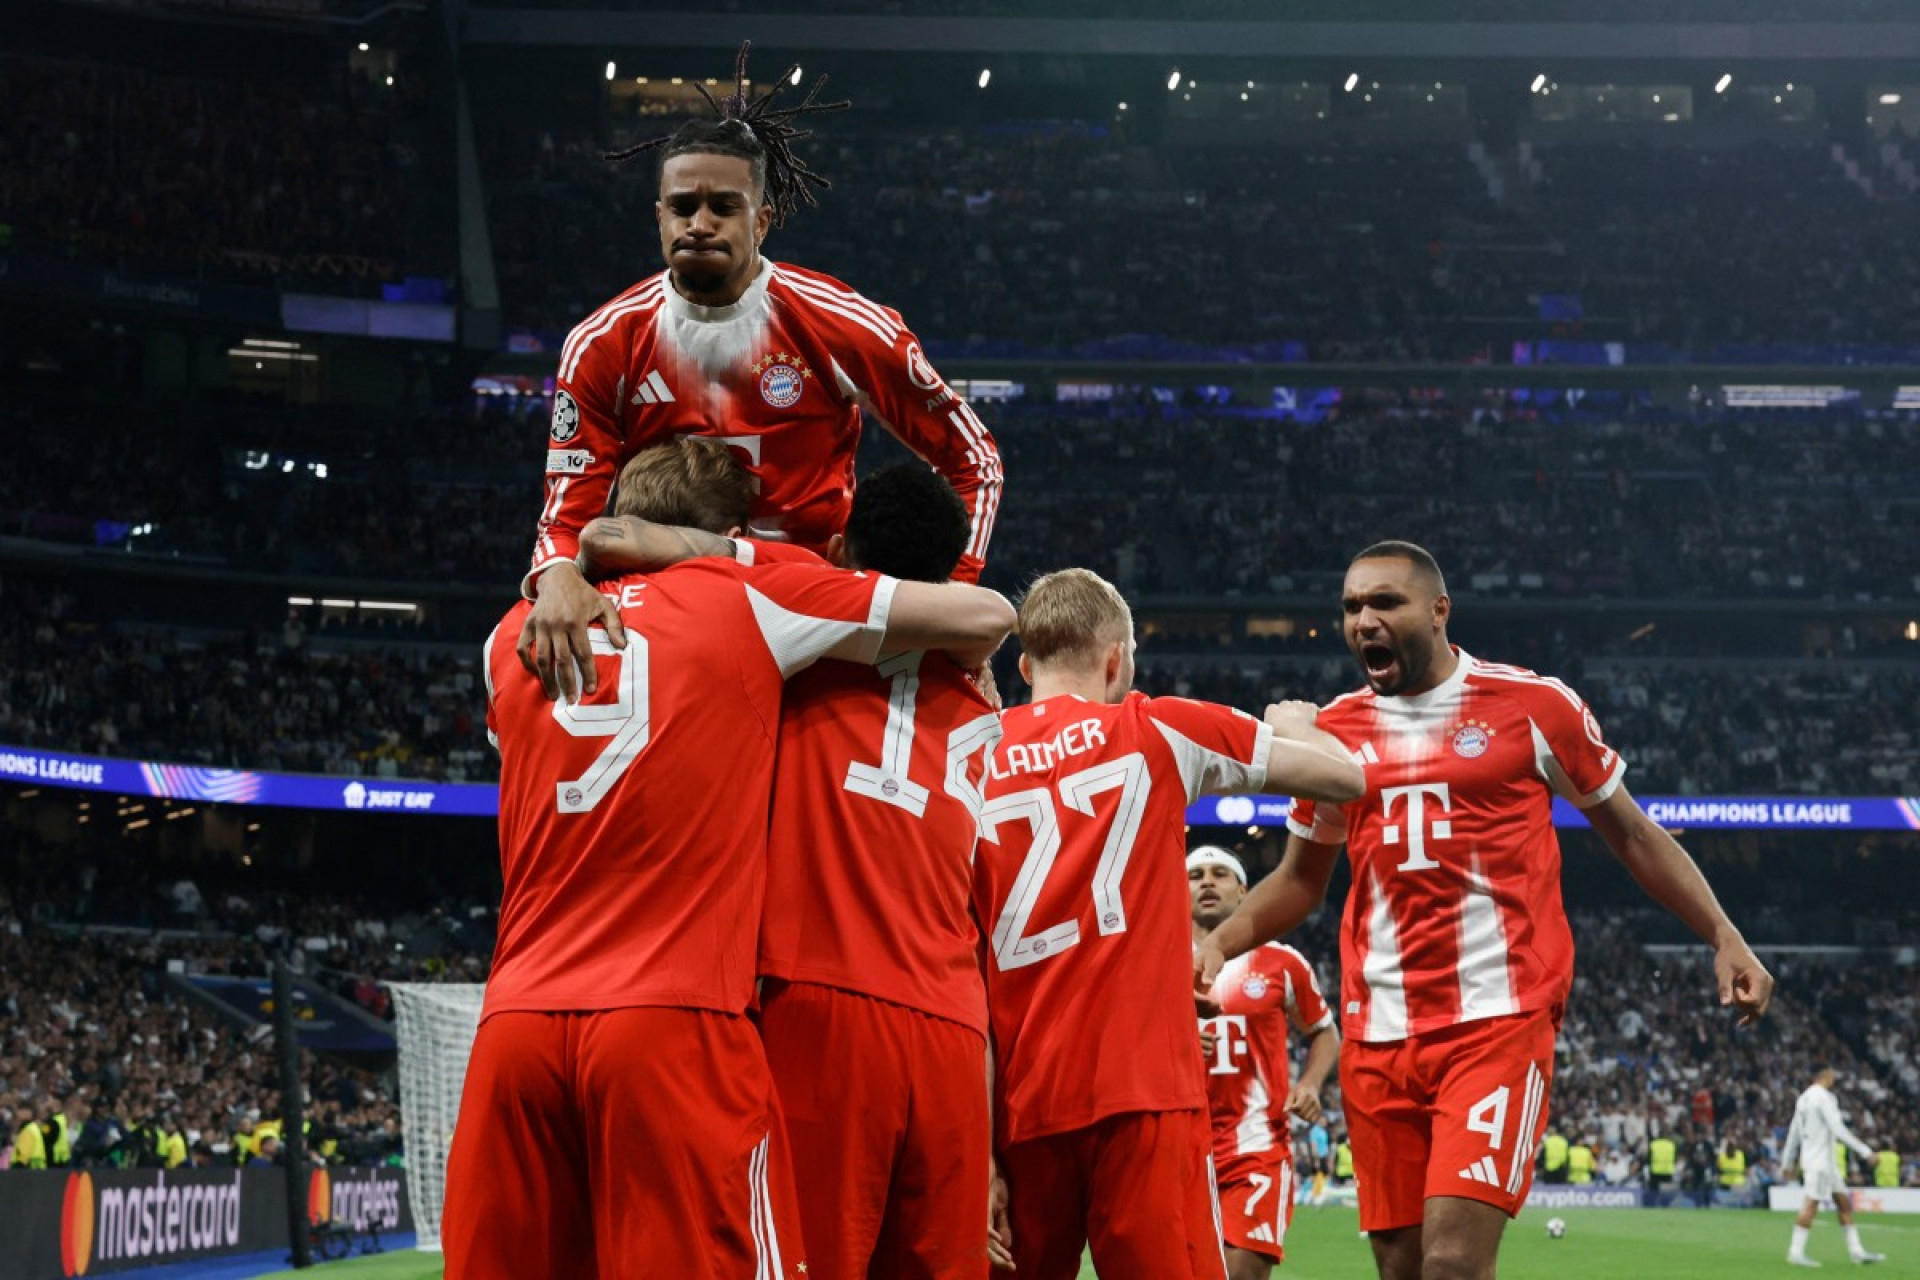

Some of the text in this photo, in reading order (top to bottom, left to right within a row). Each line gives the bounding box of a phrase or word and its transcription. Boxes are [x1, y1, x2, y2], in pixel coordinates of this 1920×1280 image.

[552, 628, 649, 814] 9
[989, 718, 1107, 780] LAIMER
[39, 757, 103, 784] LEAGUE
[367, 790, 435, 809] JUST EAT
[1381, 782, 1452, 872] T
[1648, 803, 1852, 823] CHAMPIONS LEAGUE
[979, 752, 1152, 972] 27
[1197, 1015, 1247, 1075] T
[1466, 1085, 1510, 1150] 4
[98, 1168, 241, 1260] mastercard
[1244, 1173, 1272, 1216] 7
